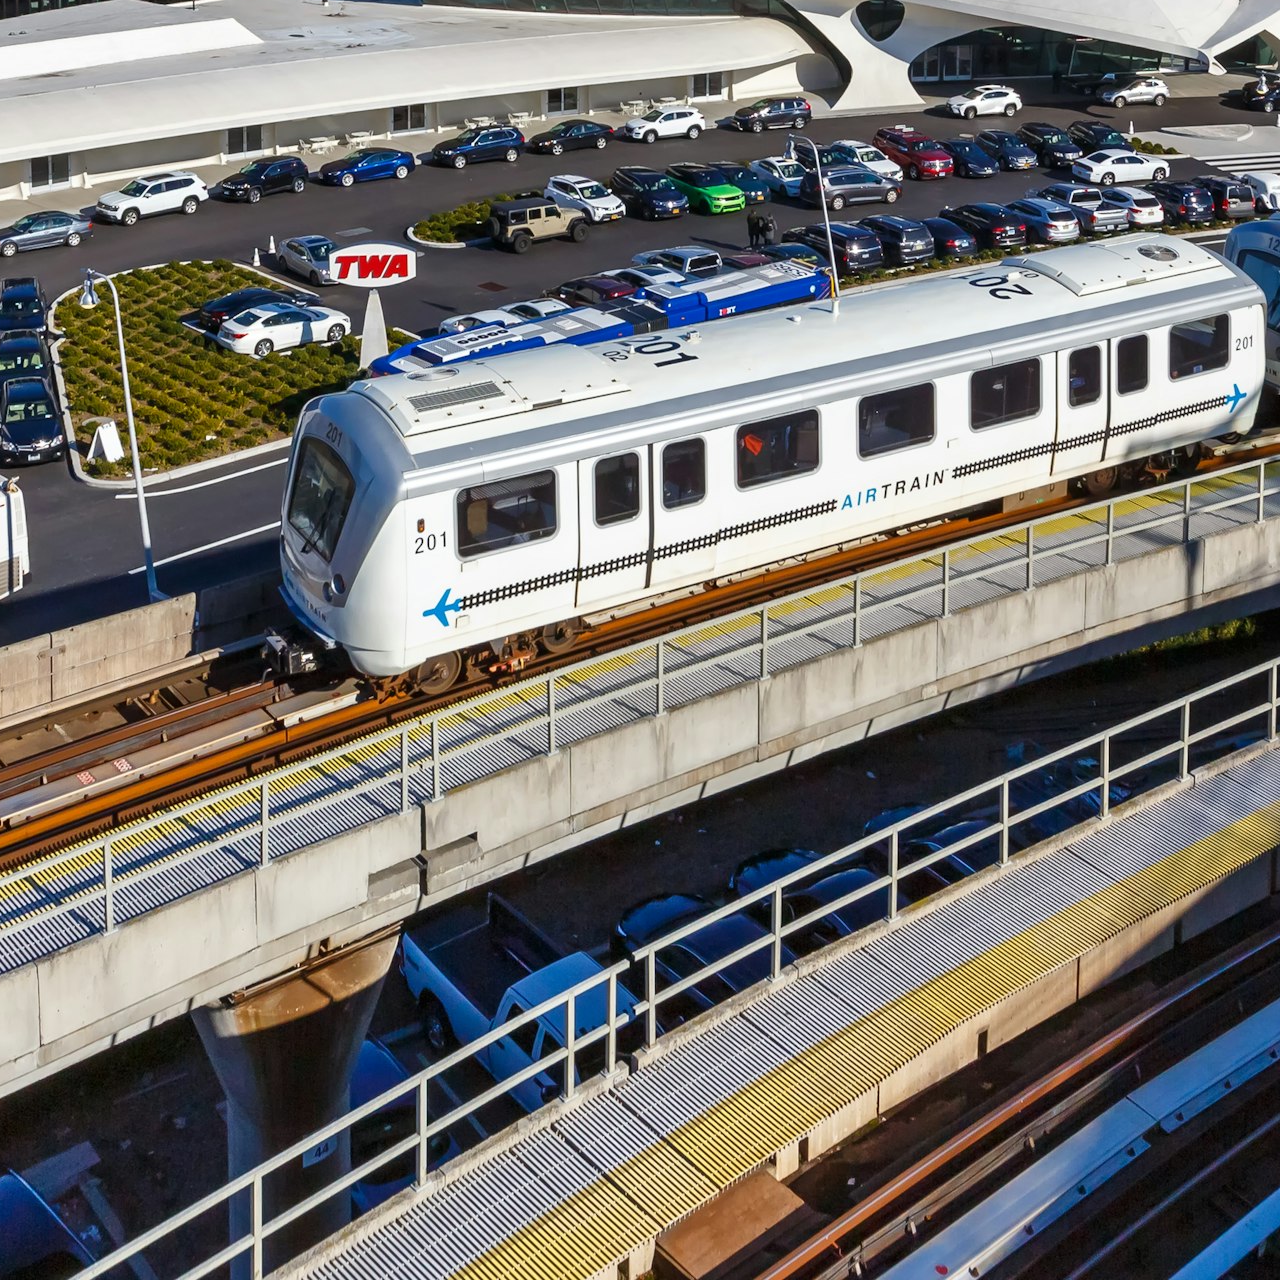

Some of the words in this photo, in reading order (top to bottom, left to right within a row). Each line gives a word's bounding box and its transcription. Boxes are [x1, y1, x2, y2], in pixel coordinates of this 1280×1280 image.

[335, 254, 409, 279] TWA
[613, 335, 699, 368] 201
[1235, 335, 1253, 351] 201
[325, 422, 343, 448] 201
[841, 469, 945, 511] AIRTRAIN
[415, 531, 447, 554] 201
[315, 1142, 329, 1157] 44
